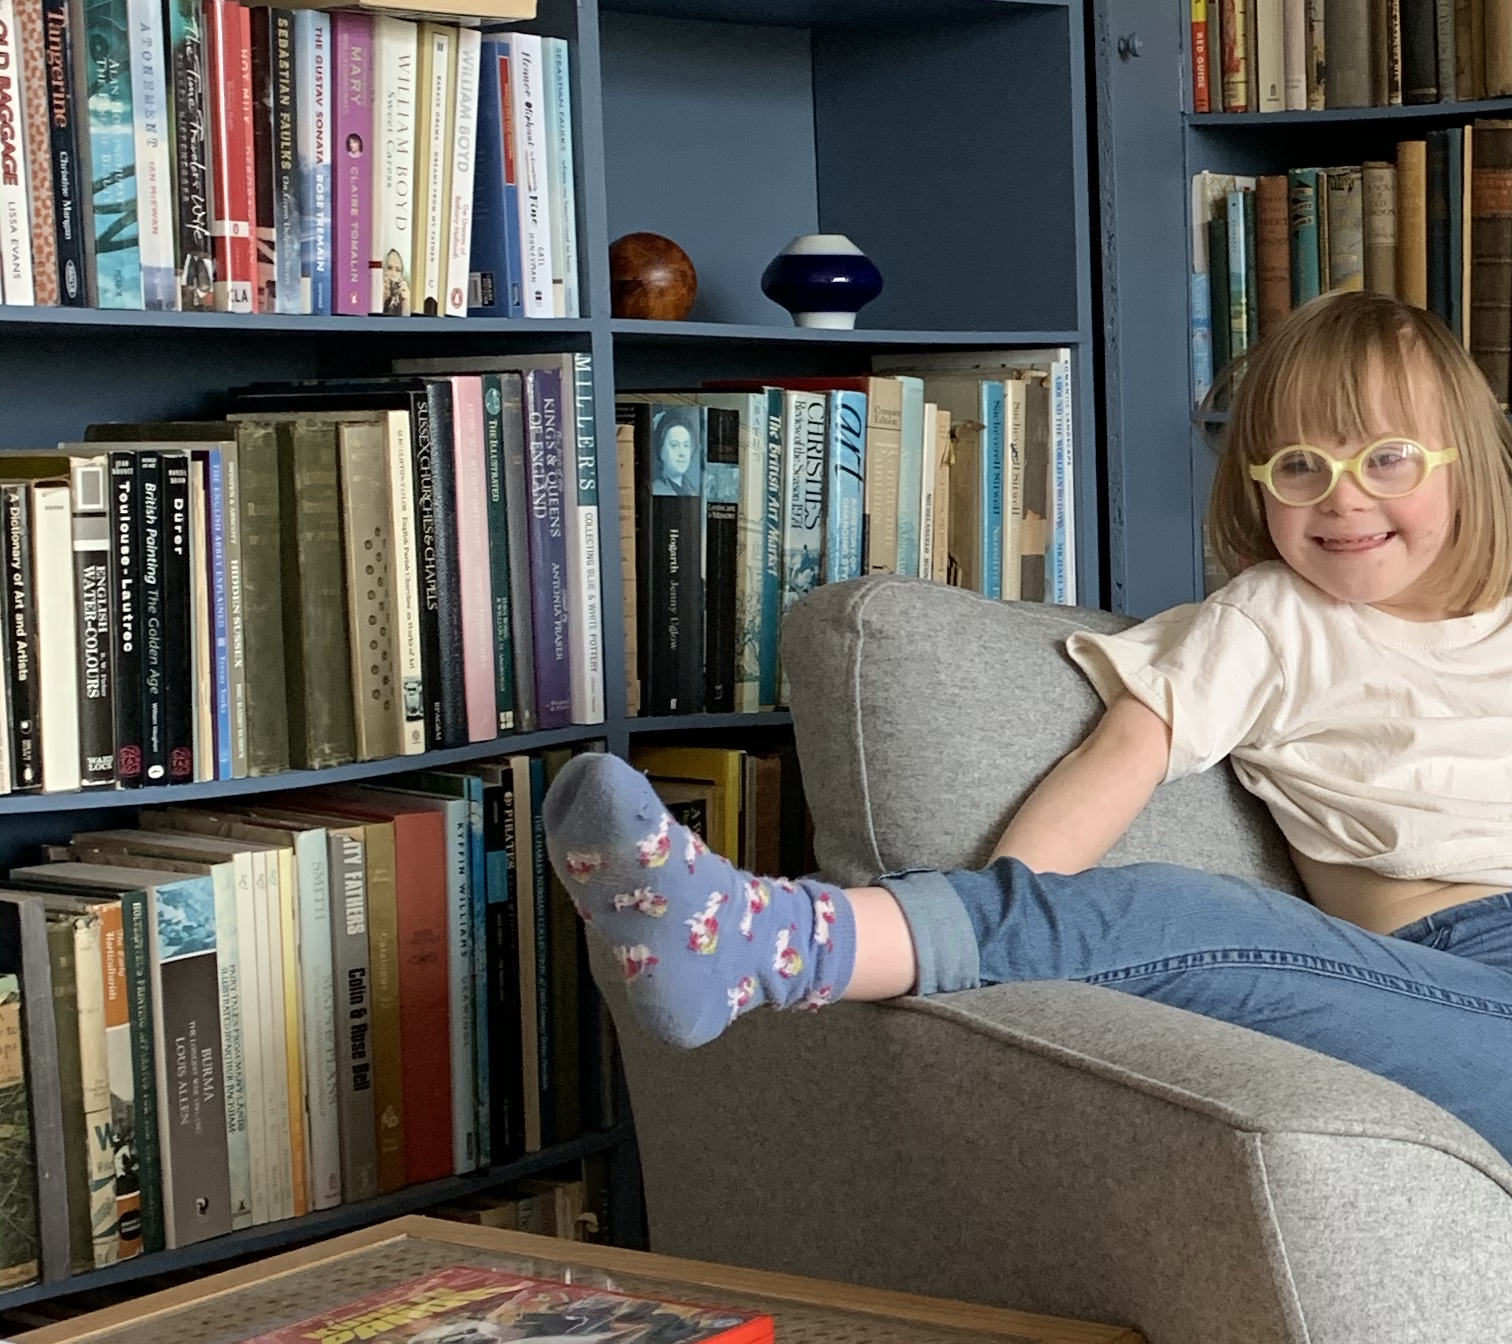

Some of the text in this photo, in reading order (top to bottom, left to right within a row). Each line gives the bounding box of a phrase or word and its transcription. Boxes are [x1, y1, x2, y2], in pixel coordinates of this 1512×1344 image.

[46, 7, 67, 129] Tangerine
[140, 22, 158, 148] ATONEMENT
[278, 18, 292, 170] SEBASTIAN FAULKS
[315, 26, 324, 164] THE GUSTAV SONATA
[350, 46, 361, 106] MARY
[1196, 32, 1205, 88] RED GUIDE
[396, 55, 410, 232] WILLIAM BOYD
[457, 50, 476, 173] WILLIAM BOYD
[58, 150, 70, 195] Christine
[7, 201, 21, 280] LISSA EVANS
[316, 174, 324, 272] ROSE TREMAIN
[350, 167, 359, 283] CLAIRE TOMALIN
[544, 398, 556, 448] KINGS
[575, 356, 595, 491] MILLER'S
[532, 437, 546, 519] ENGLAND
[548, 470, 560, 538] QUEENS
[768, 441, 782, 493] British
[584, 512, 593, 567] COLLECTING
[768, 497, 780, 523] Art
[145, 483, 160, 695] British Painting The Golden Age
[668, 529, 679, 574] Hogarth
[10, 506, 28, 681] Dictionary of Art and Artists
[96, 565, 108, 633] ENGLISH
[231, 559, 241, 668] HIDDEN SUSSEX
[588, 603, 597, 630] WHITE
[84, 565, 100, 698] WATER-COLOURS
[346, 870, 366, 936] FATHERS
[458, 883, 468, 958] WILLIAMS
[348, 968, 366, 1007] Colin
[200, 1047, 214, 1102] BURMA
[351, 1024, 367, 1059] Rose
[352, 1063, 370, 1092] Bell
[175, 1036, 190, 1125] LOUIS ALLEN
